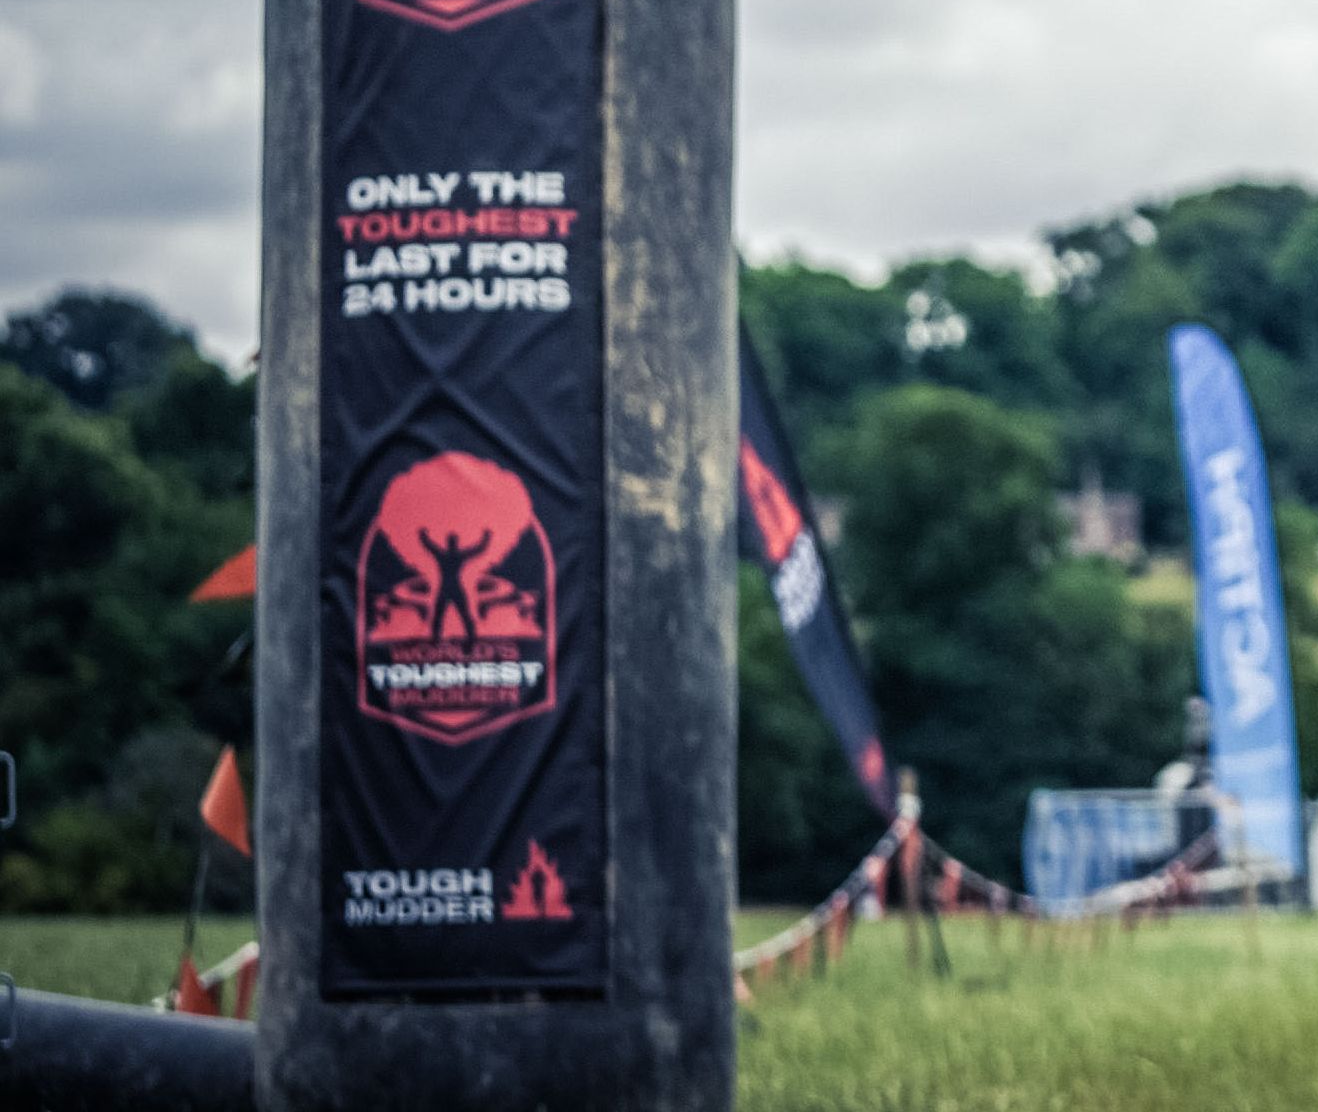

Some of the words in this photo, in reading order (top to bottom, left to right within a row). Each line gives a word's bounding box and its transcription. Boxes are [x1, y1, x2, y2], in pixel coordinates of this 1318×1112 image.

[347, 172, 461, 210] ONLY
[468, 171, 566, 205] THE
[337, 208, 580, 244] TOUGHEST
[344, 244, 461, 281] LAST
[467, 242, 568, 275] FOR
[342, 282, 397, 318] 24
[403, 277, 573, 312] HOURS
[367, 661, 544, 691] TOUGHEST
[342, 868, 494, 898] TOUGH
[344, 896, 494, 927] MUDDER
